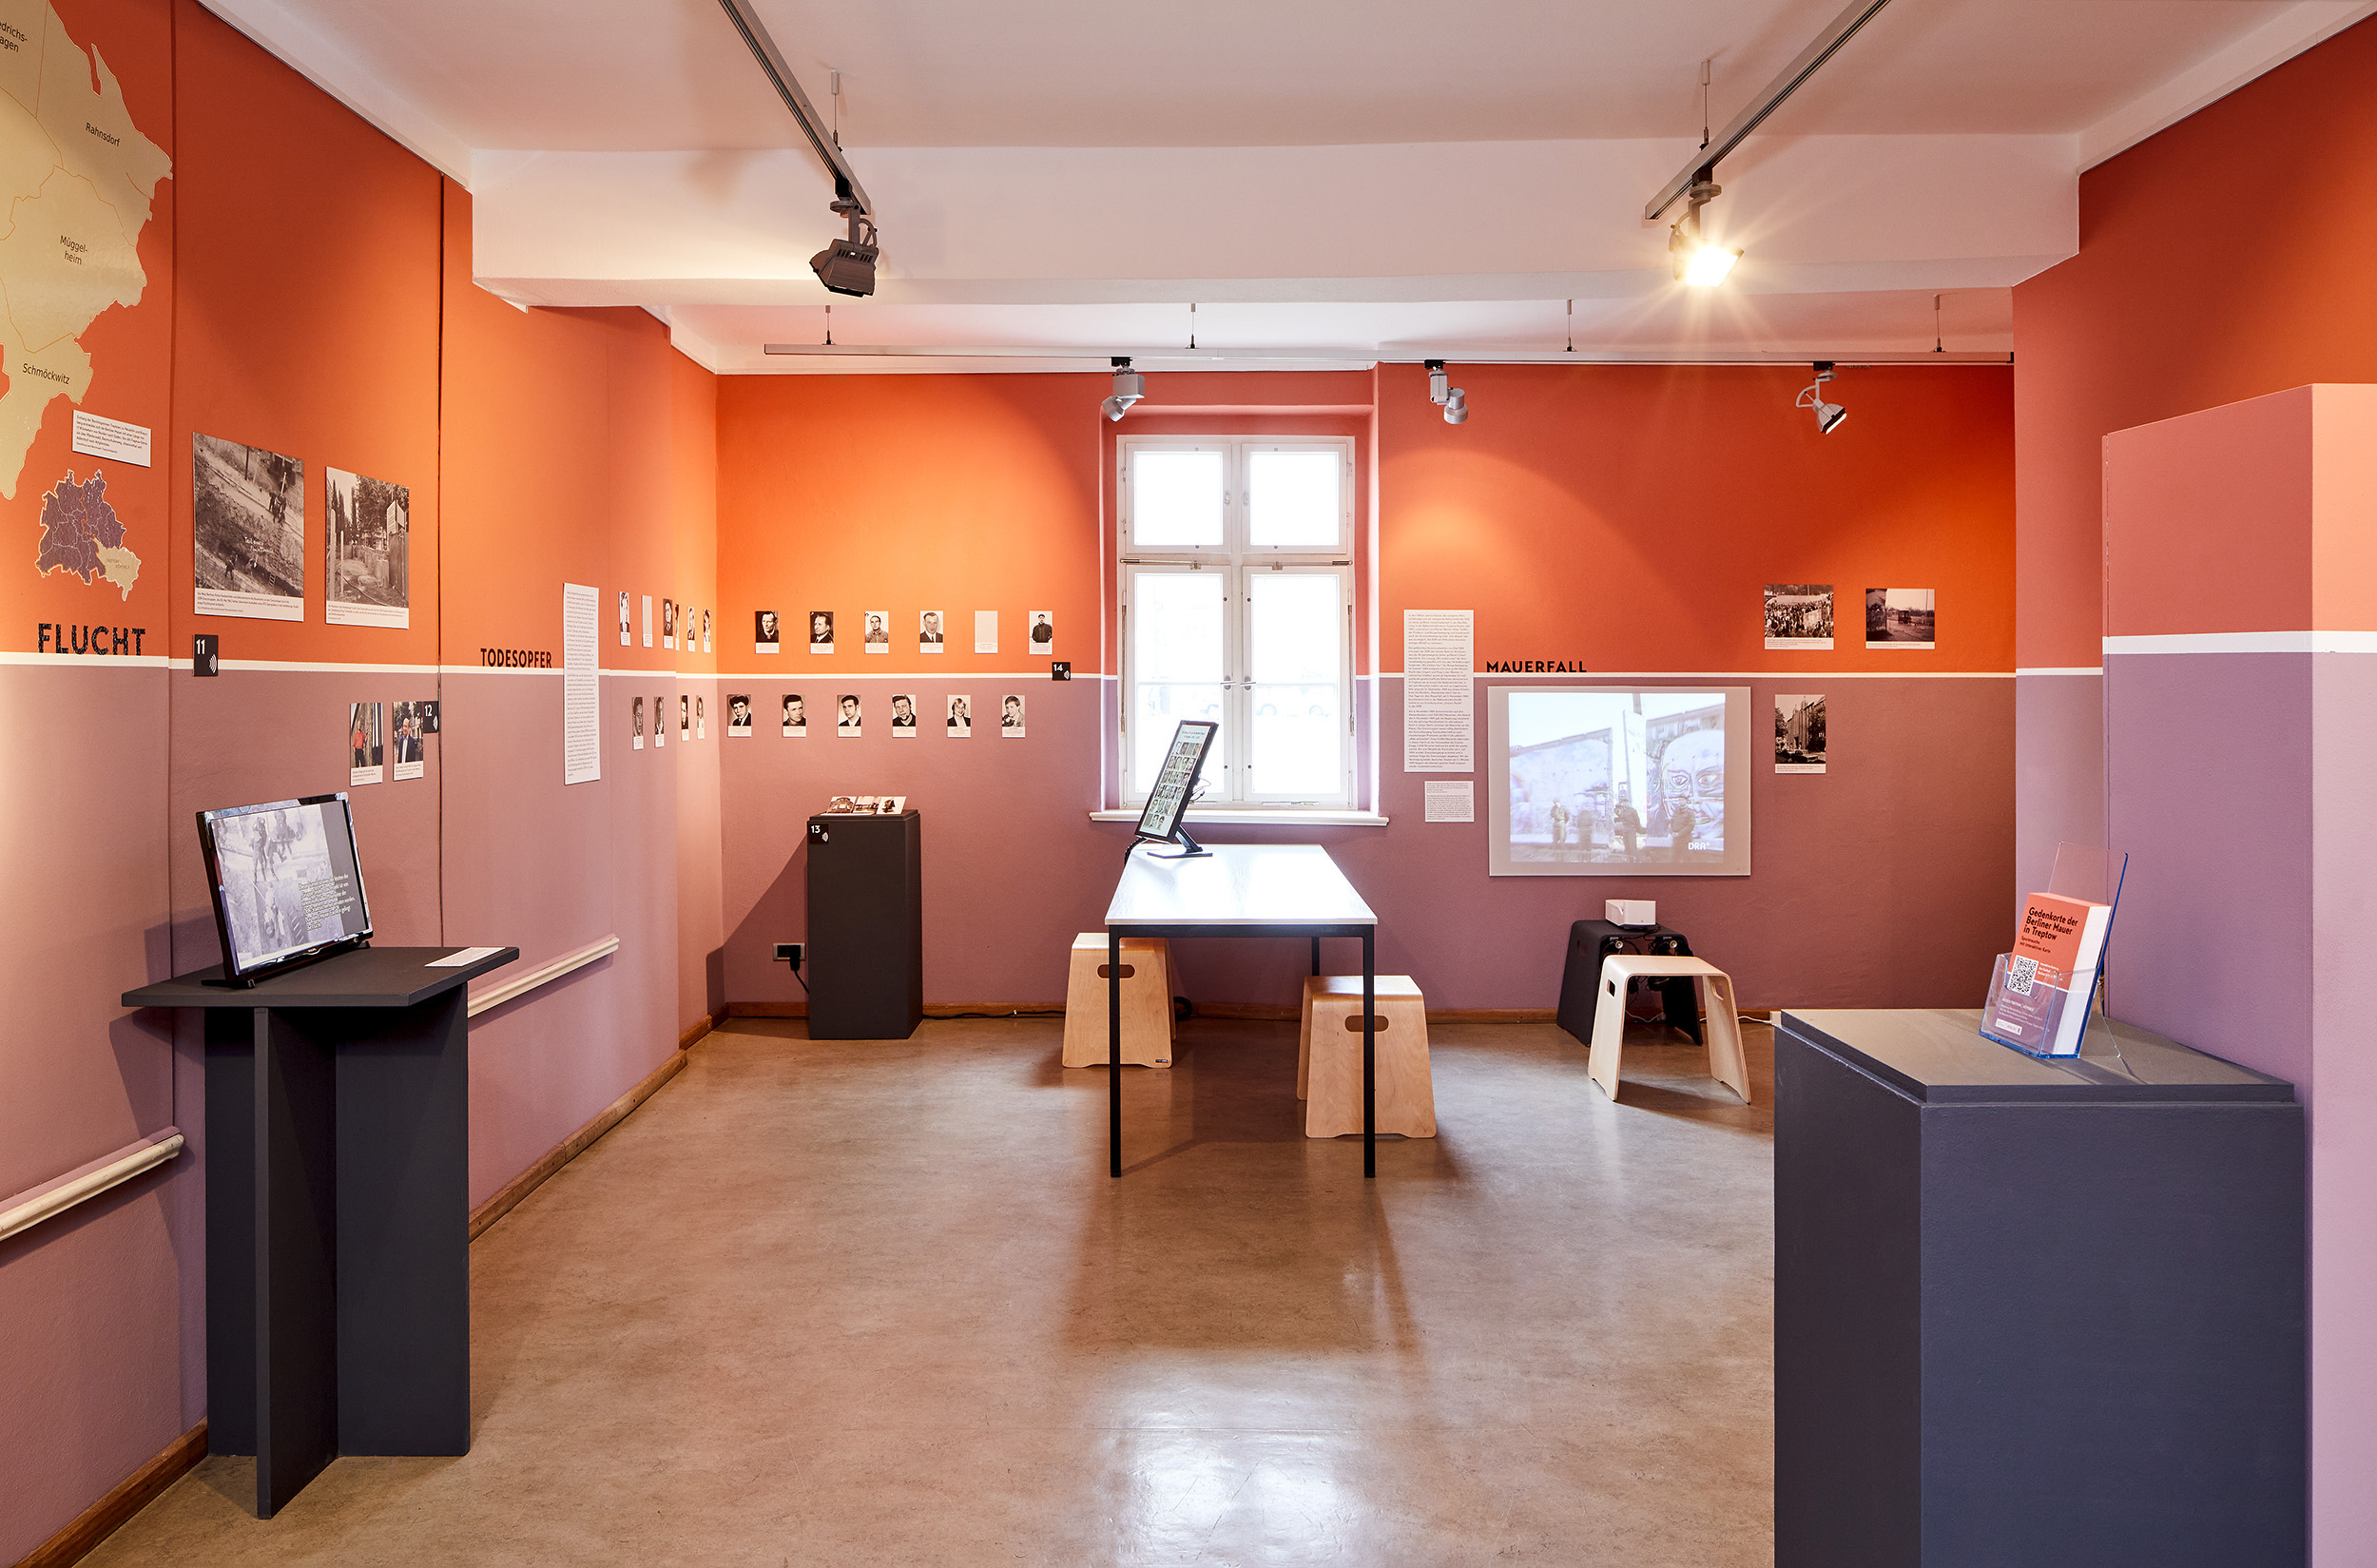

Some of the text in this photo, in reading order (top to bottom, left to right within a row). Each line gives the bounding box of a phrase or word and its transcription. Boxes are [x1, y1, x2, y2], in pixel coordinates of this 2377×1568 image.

[86, 122, 121, 147] Rahnsdorf
[60, 235, 88, 254] Müggel-
[64, 251, 83, 265] heim
[22, 362, 70, 385] Schmöckwitz
[38, 623, 146, 656] FLUCHT
[196, 639, 206, 655] 11
[480, 648, 552, 668] TODESOPFER
[1053, 664, 1064, 672] 14
[1486, 661, 1587, 673] MAUERFALL
[424, 704, 433, 717] 12
[810, 824, 821, 834] 13
[2029, 906, 2078, 927] Gedenkorte der
[2022, 924, 2058, 940] in Treptow
[2026, 916, 2073, 936] Berliner Mauer
